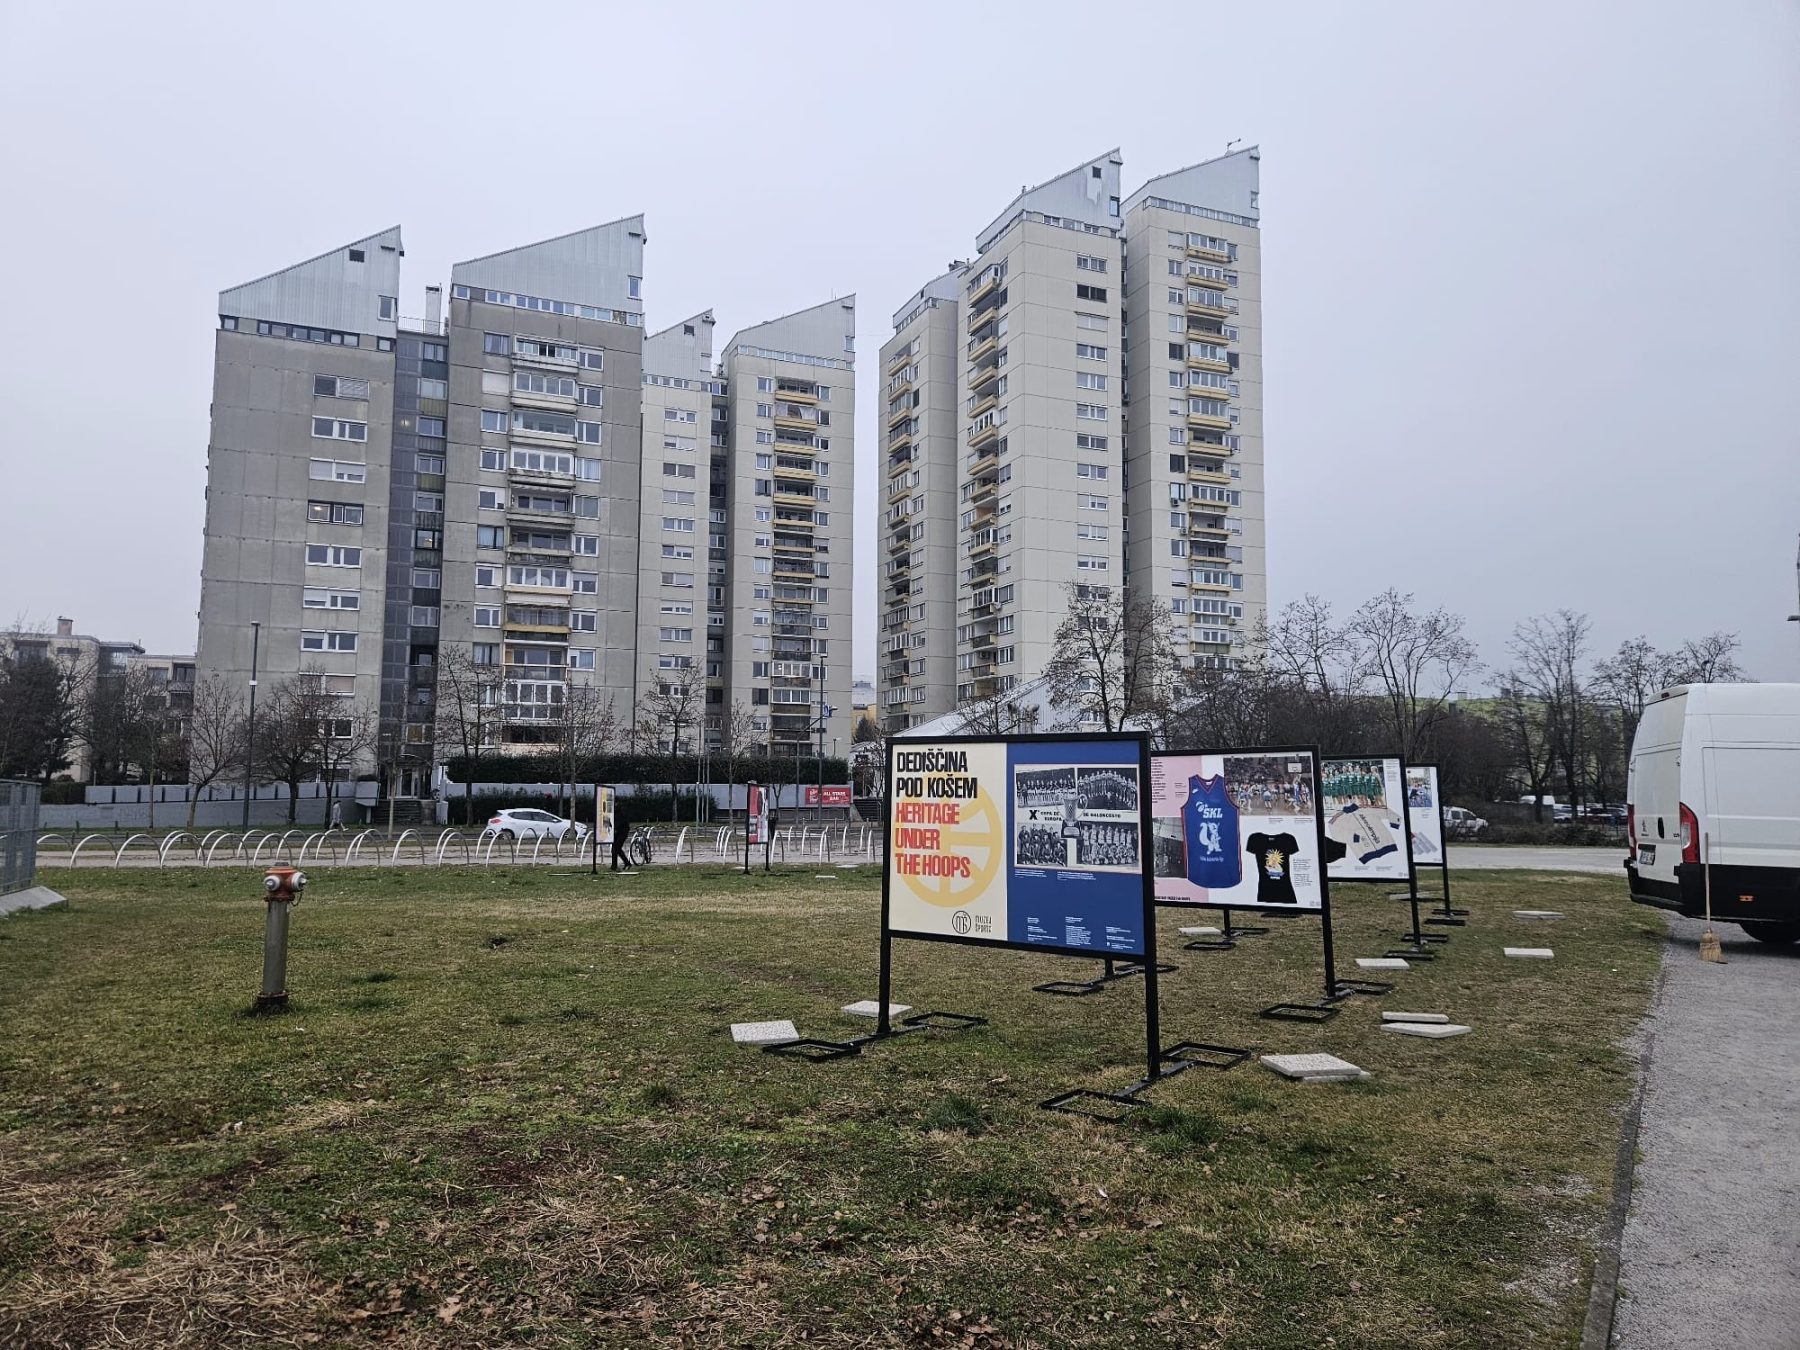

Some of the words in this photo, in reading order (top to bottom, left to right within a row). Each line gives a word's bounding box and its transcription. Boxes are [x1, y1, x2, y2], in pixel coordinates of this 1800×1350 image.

[896, 748, 968, 773] DEDIŠČINA
[896, 777, 923, 798] POD
[927, 773, 978, 799] KOŠEM
[896, 802, 960, 825] HERITAGE
[1203, 807, 1223, 819] SKL
[895, 828, 940, 850] UNDER
[895, 853, 920, 875] THE
[922, 854, 971, 878] HOOPS
